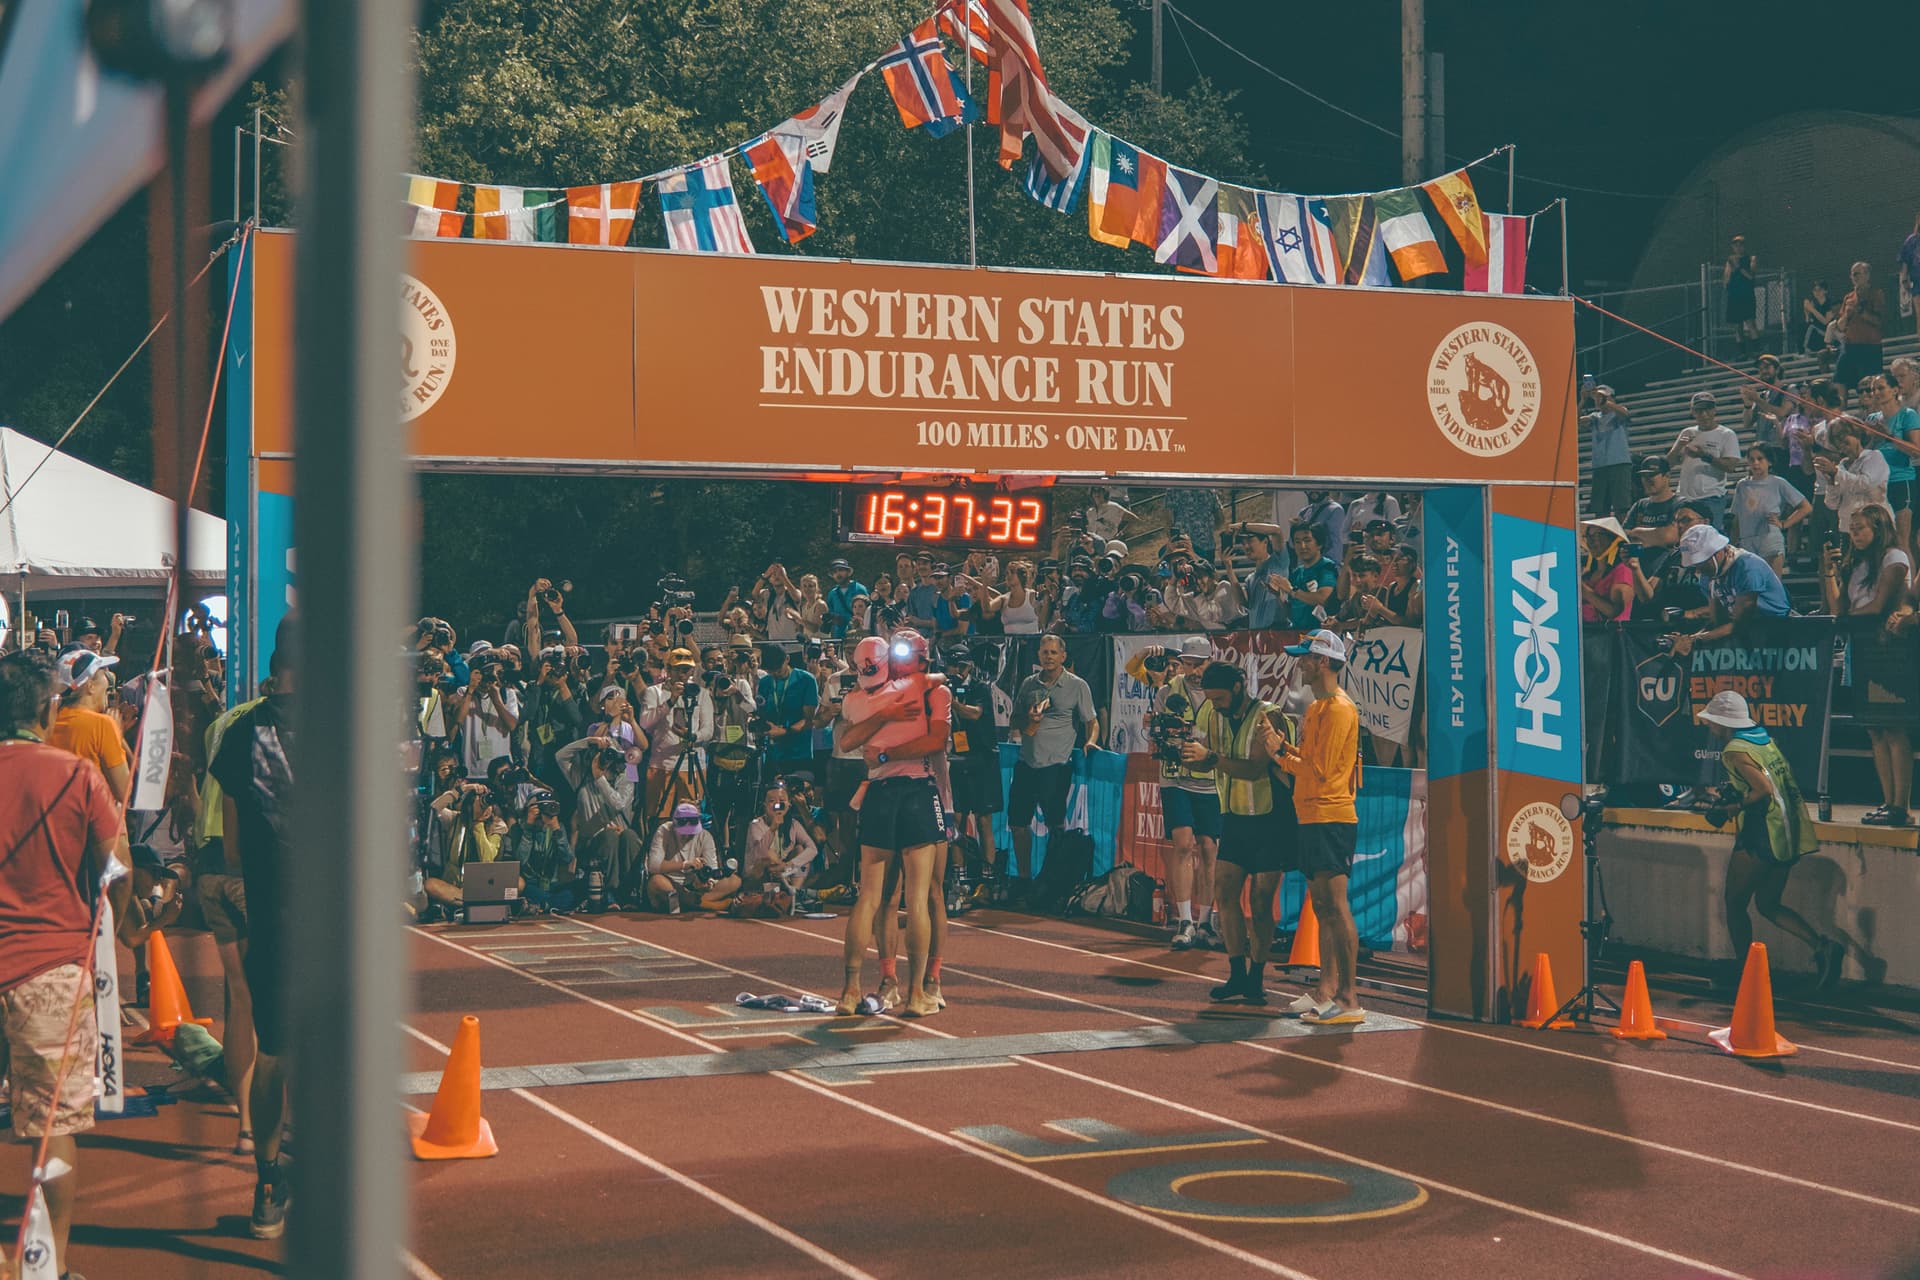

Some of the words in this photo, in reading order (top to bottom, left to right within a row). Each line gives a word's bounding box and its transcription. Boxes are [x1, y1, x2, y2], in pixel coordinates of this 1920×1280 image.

[402, 283, 444, 331] TATES
[759, 285, 1002, 343] WESTERN
[1018, 297, 1185, 351] STATES
[430, 339, 450, 347] ONE
[431, 349, 449, 357] DAY
[1435, 328, 1490, 371] WESTERN
[1493, 331, 1532, 376] STATES
[413, 364, 446, 403] RUN
[759, 346, 1061, 403] ENDURANCE
[1075, 358, 1175, 407] RUN
[1522, 382, 1537, 390] ONE
[916, 421, 961, 446] 100
[966, 422, 1049, 448] MILES
[1065, 425, 1118, 450] ONE
[1436, 403, 1511, 451] ENDURANCE
[1511, 405, 1534, 437] RUN
[1446, 536, 1459, 577] FLY
[1447, 582, 1464, 681] HUMAN
[1512, 551, 1562, 751] HOKA
[1350, 638, 1411, 678] TRA
[1691, 648, 1818, 671] HYDRATION
[1344, 665, 1410, 711] NING
[1451, 686, 1465, 727] FLY
[1640, 677, 1676, 701] GU
[1690, 676, 1774, 699] ENERGY
[1692, 703, 1807, 727] RVERY
[932, 794, 945, 832] TERREX
[1511, 805, 1544, 833] WESTERN
[1544, 808, 1568, 833] STATES
[101, 1031, 118, 1098] HOKA
